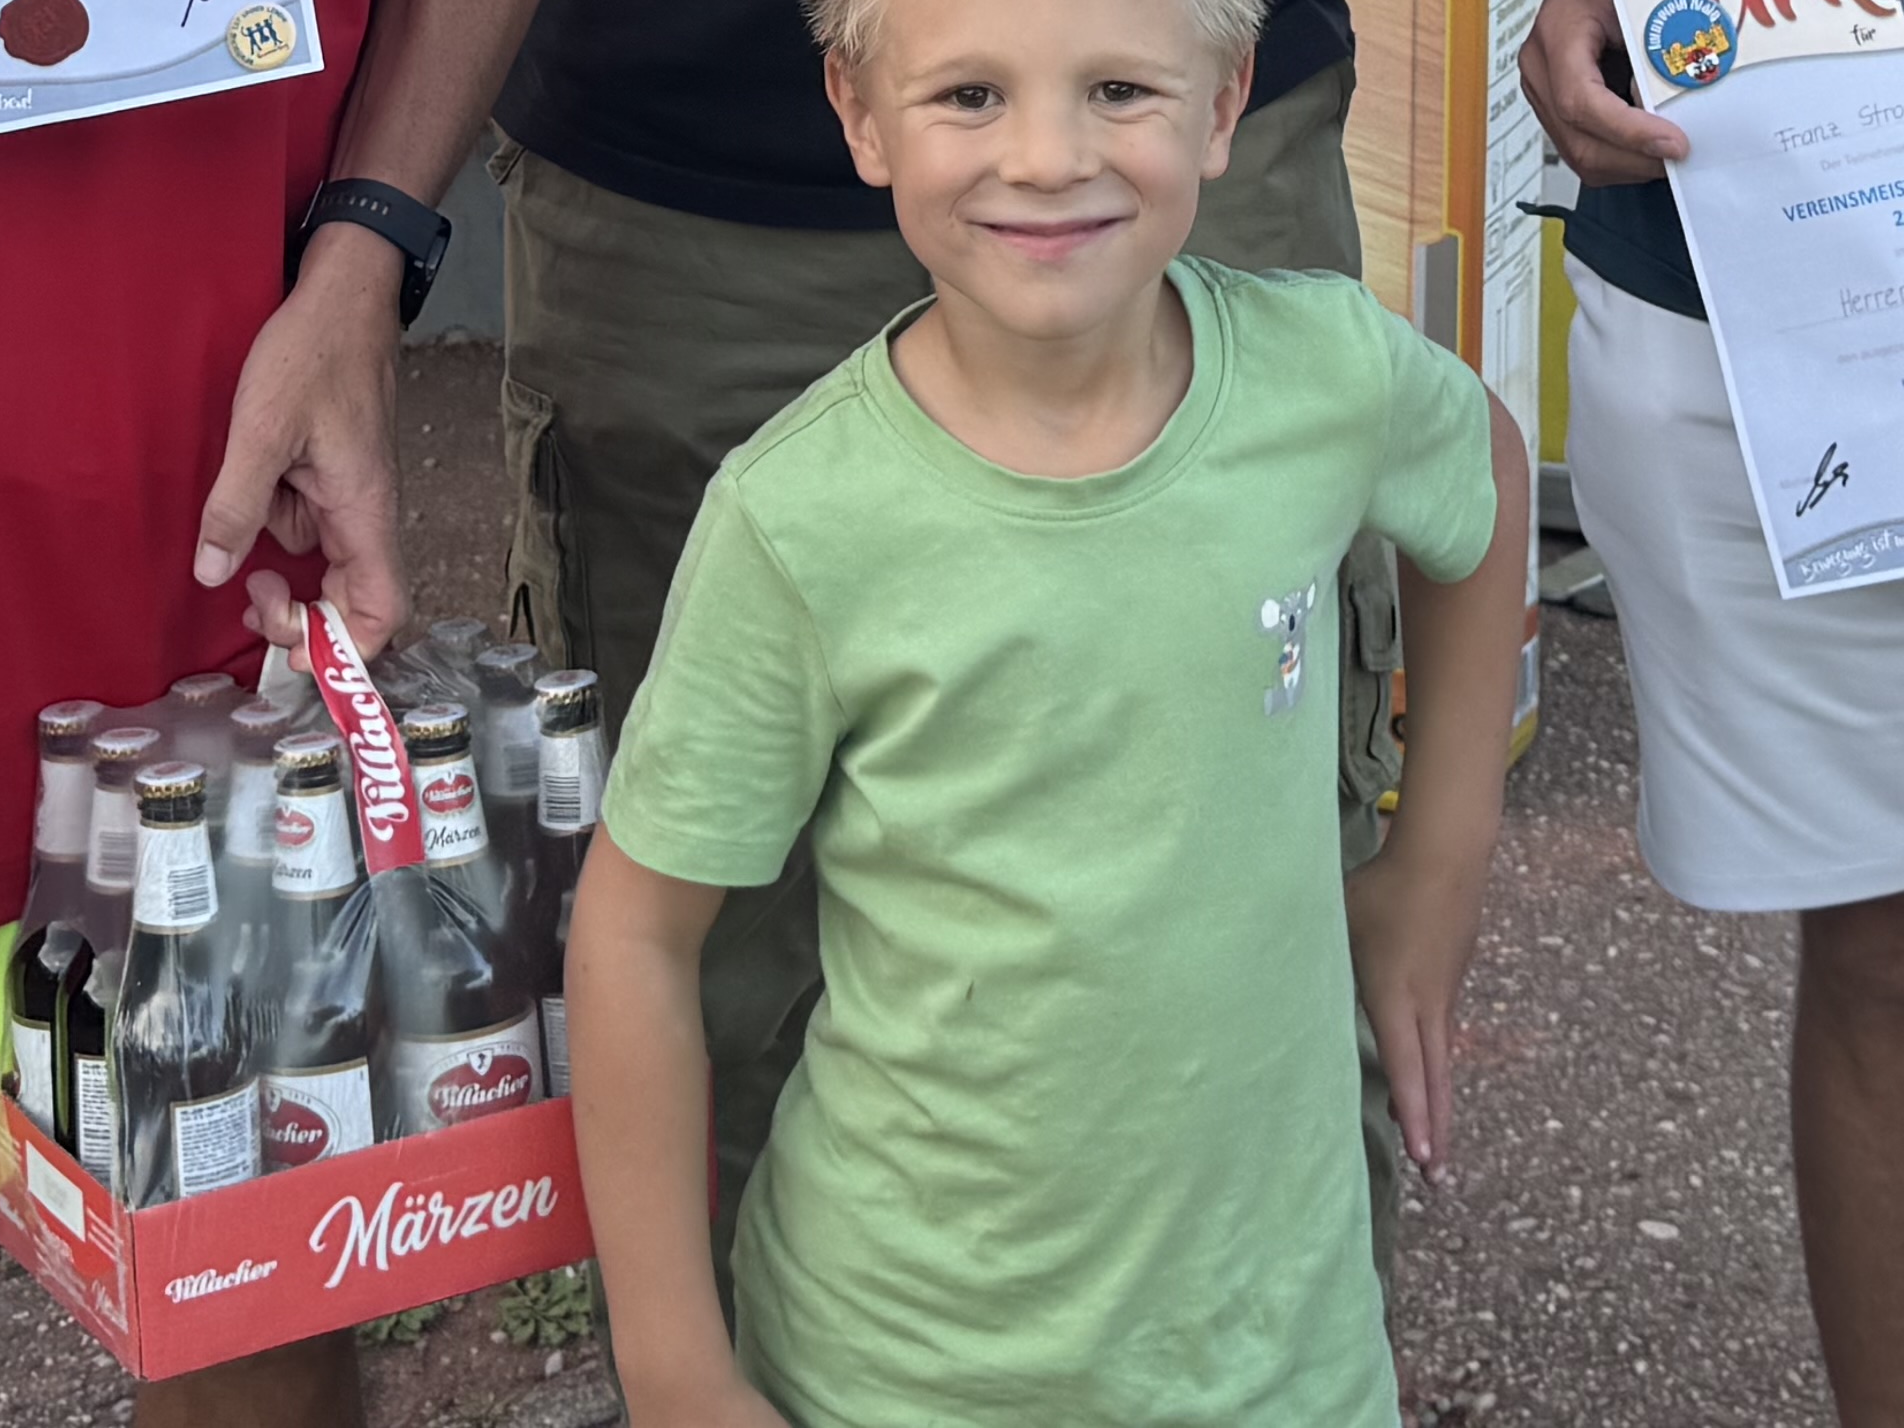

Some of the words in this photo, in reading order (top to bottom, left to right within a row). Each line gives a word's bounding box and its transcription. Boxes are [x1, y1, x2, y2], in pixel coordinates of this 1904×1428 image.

[1774, 121, 1842, 152] Franz
[165, 1257, 277, 1304] Villacher
[308, 1175, 558, 1290] Märzen
